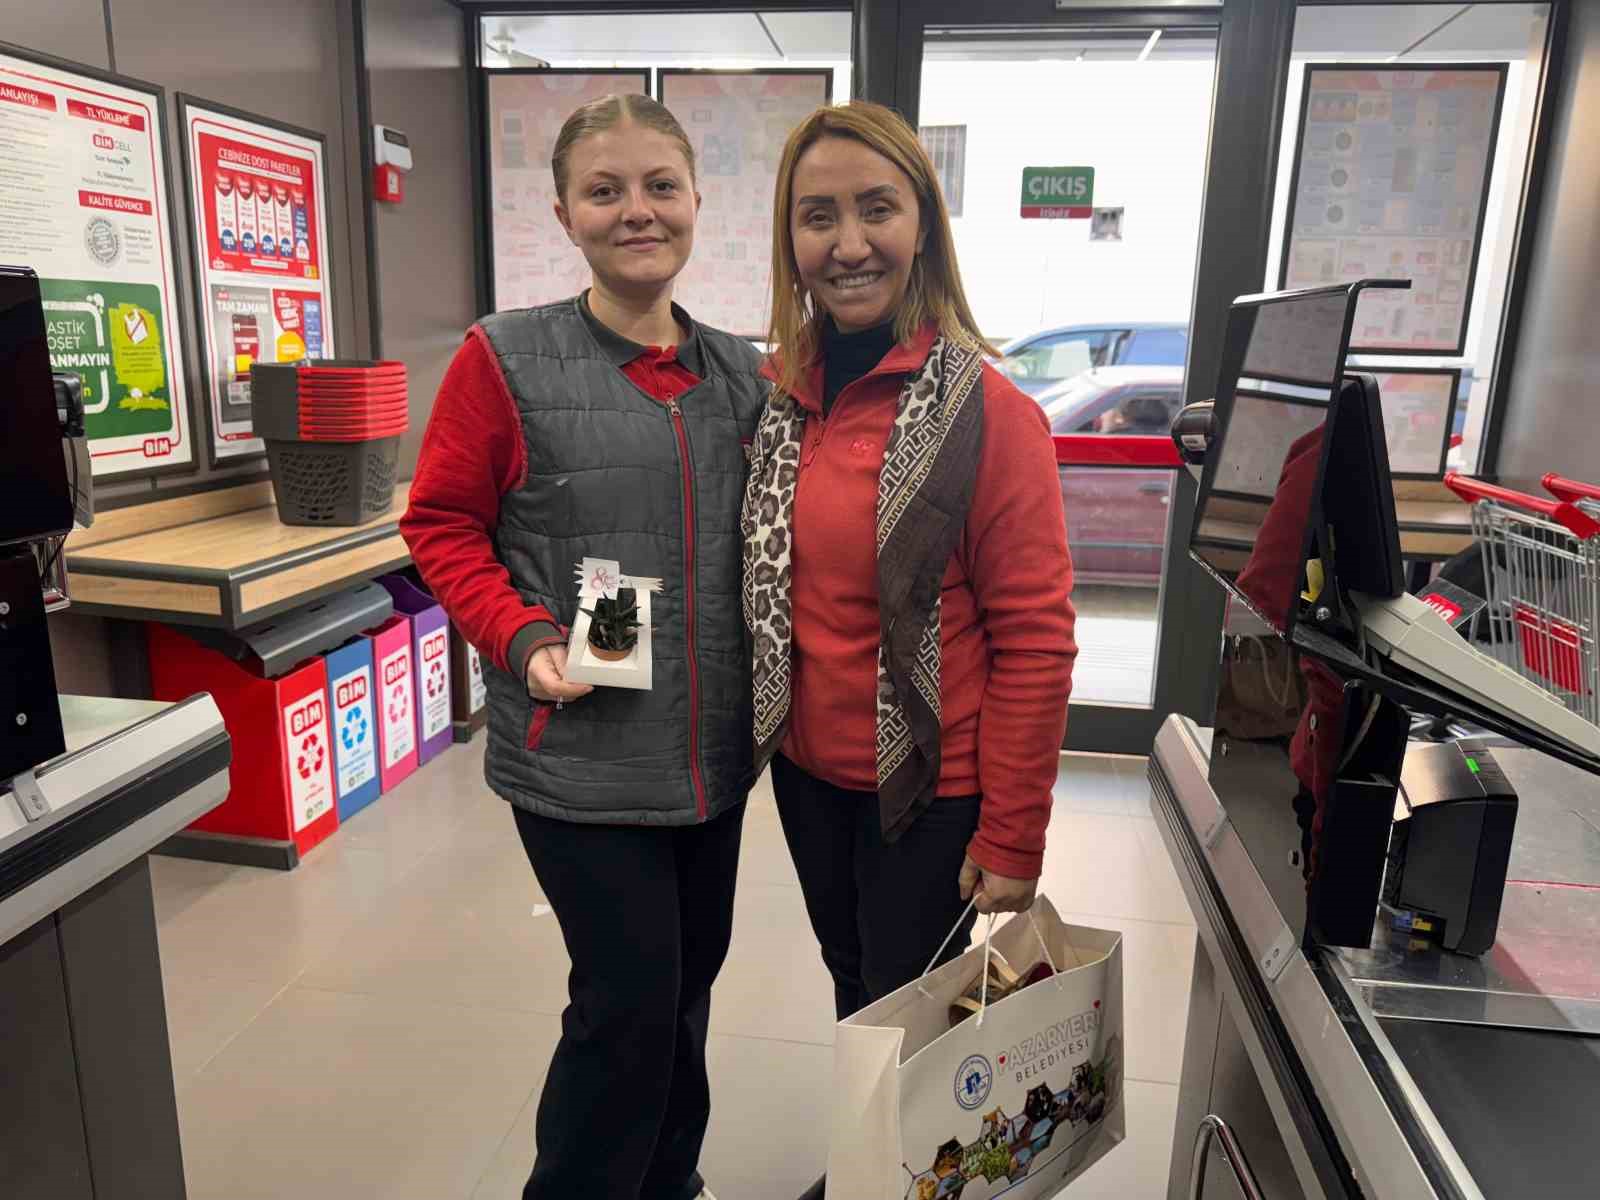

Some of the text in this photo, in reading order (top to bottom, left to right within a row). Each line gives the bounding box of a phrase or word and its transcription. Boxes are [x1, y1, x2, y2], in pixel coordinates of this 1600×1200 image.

[1028, 176, 1087, 200] ÇIKIŞ
[48, 320, 86, 335] ASTİK
[48, 336, 80, 351] OŞET
[50, 353, 110, 368] ANMAYIN
[424, 635, 445, 662] BIM
[385, 656, 407, 685] BIM
[337, 677, 366, 708] BIM
[292, 700, 322, 736] BIM
